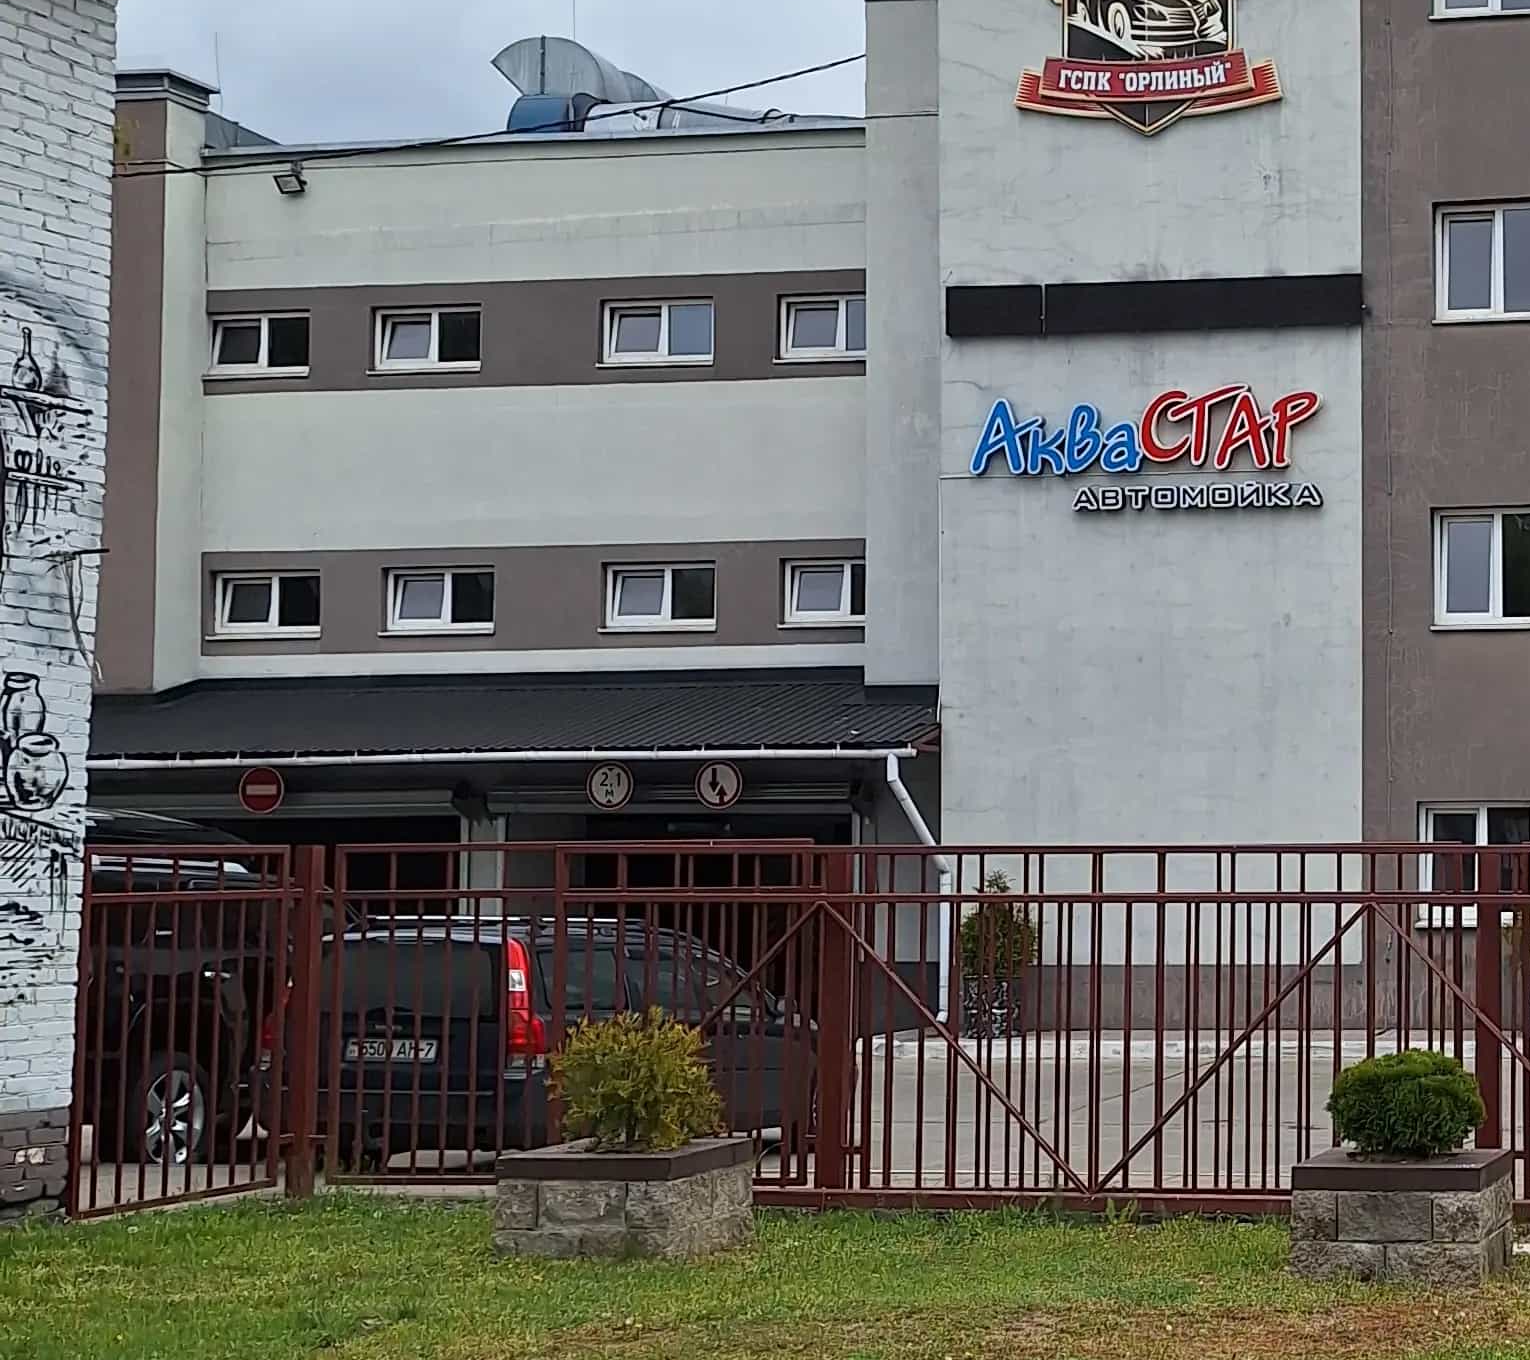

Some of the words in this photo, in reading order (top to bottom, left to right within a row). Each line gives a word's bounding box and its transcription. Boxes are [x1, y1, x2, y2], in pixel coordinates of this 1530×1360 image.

[1059, 69, 1111, 91] ГСПК
[1119, 61, 1231, 92] "ОРЛИНЫЙ"
[1072, 482, 1322, 511] АВТОМОЙКА
[600, 772, 621, 787] 2,1
